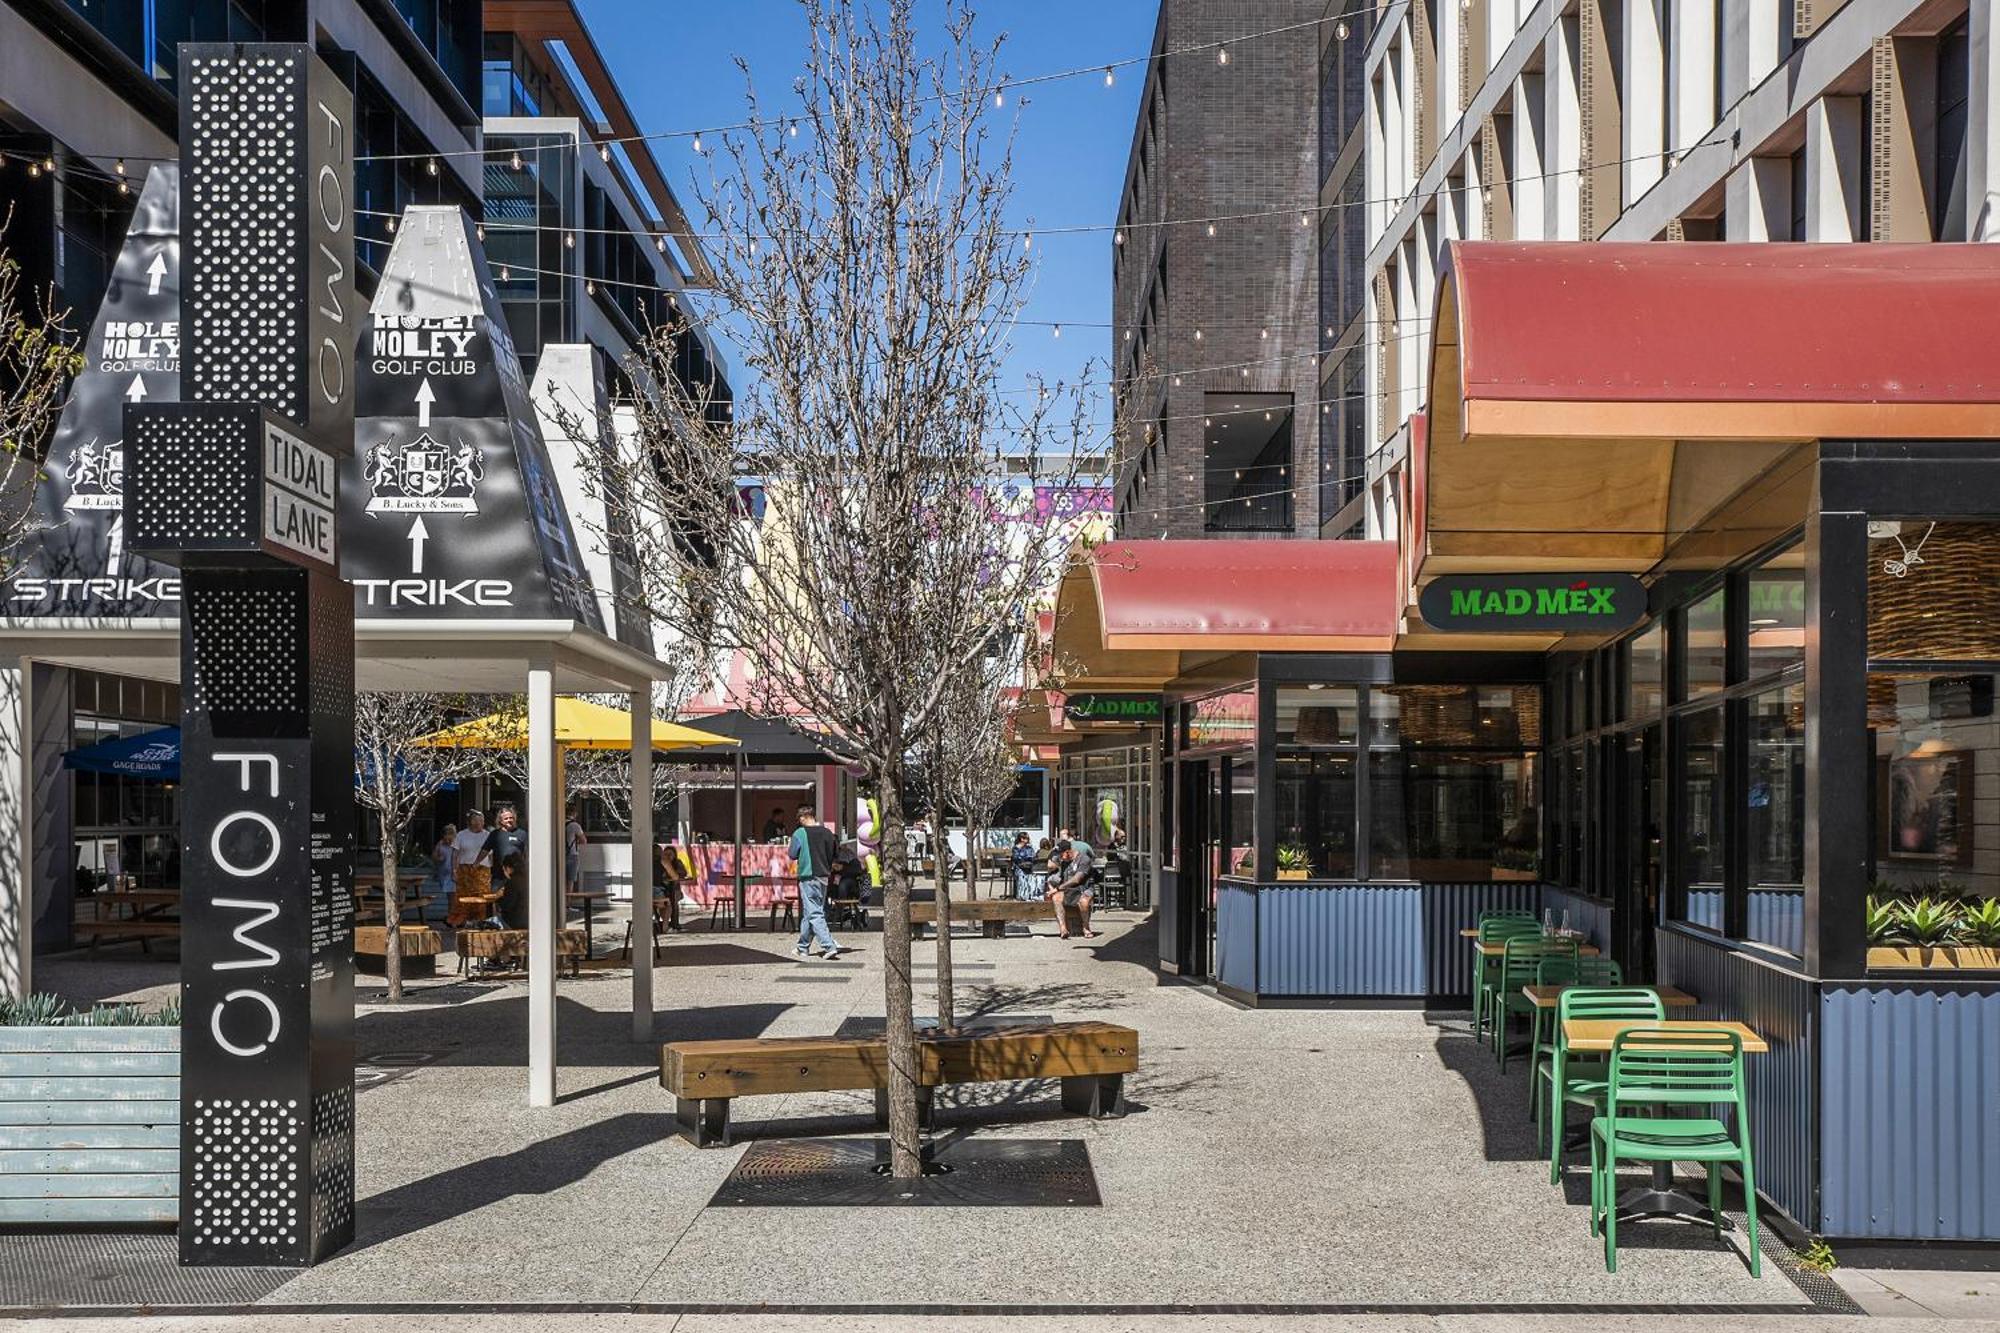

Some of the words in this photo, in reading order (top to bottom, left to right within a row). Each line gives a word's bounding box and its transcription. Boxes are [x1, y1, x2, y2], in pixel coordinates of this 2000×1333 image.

[318, 100, 344, 405] FOMO
[105, 321, 180, 338] HOLE
[102, 338, 181, 359] MOLEY
[373, 330, 477, 358] MOLEY
[100, 360, 140, 373] GOLF
[372, 359, 422, 375] GOLF
[427, 359, 476, 375] CLUB
[270, 432, 331, 500] TIDAL
[96, 497, 122, 507] Luck
[396, 499, 427, 511] Lucky
[429, 500, 437, 508] &
[440, 500, 464, 508] Sons
[273, 495, 329, 554] LANE
[10, 578, 181, 601] STRIKE
[344, 579, 514, 606] TRIKE
[1450, 588, 1532, 616] MAD
[211, 753, 281, 1057] FOMO
